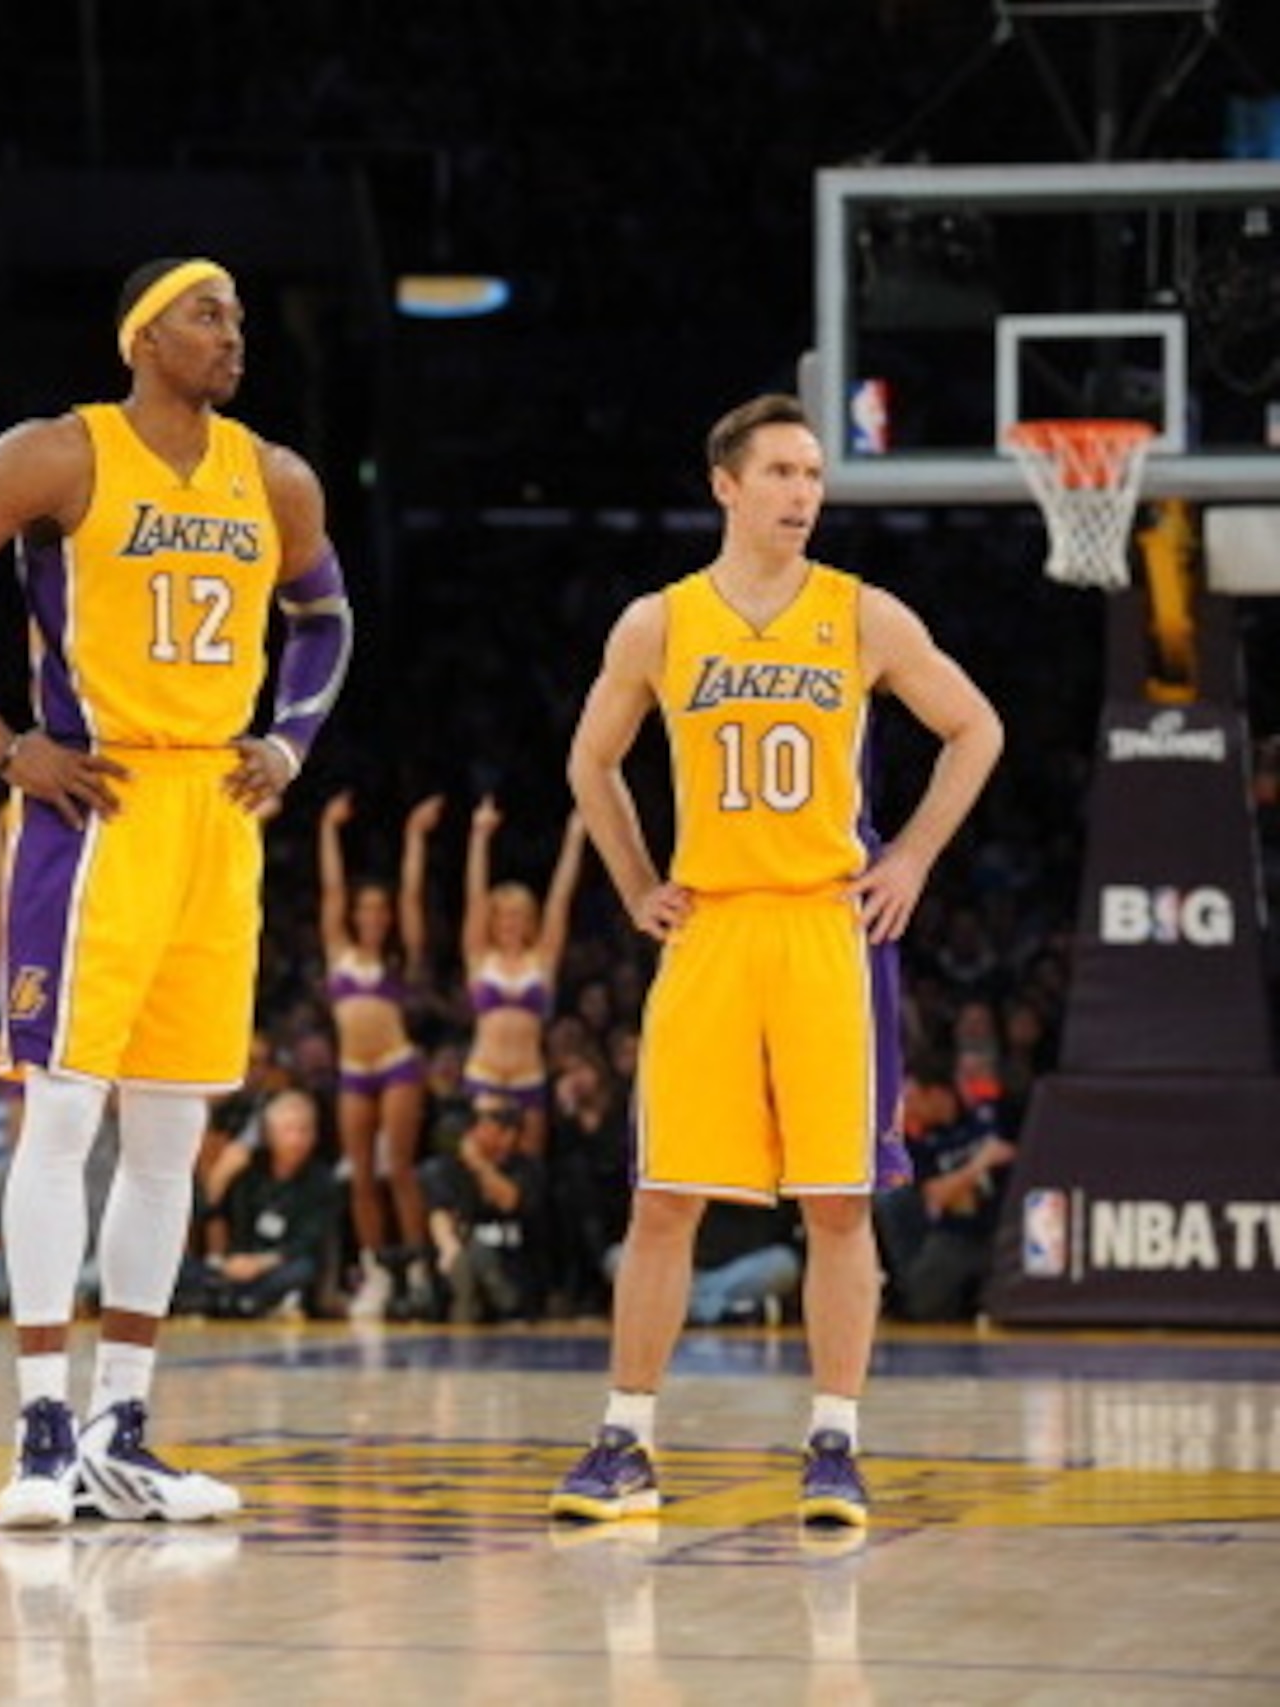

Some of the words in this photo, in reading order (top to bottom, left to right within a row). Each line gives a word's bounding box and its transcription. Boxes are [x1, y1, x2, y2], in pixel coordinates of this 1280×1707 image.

[119, 502, 262, 562] LAKERS
[148, 571, 234, 664] 12
[683, 655, 844, 713] LAKERS
[715, 721, 813, 814] 10
[1090, 1199, 1220, 1271] NBA
